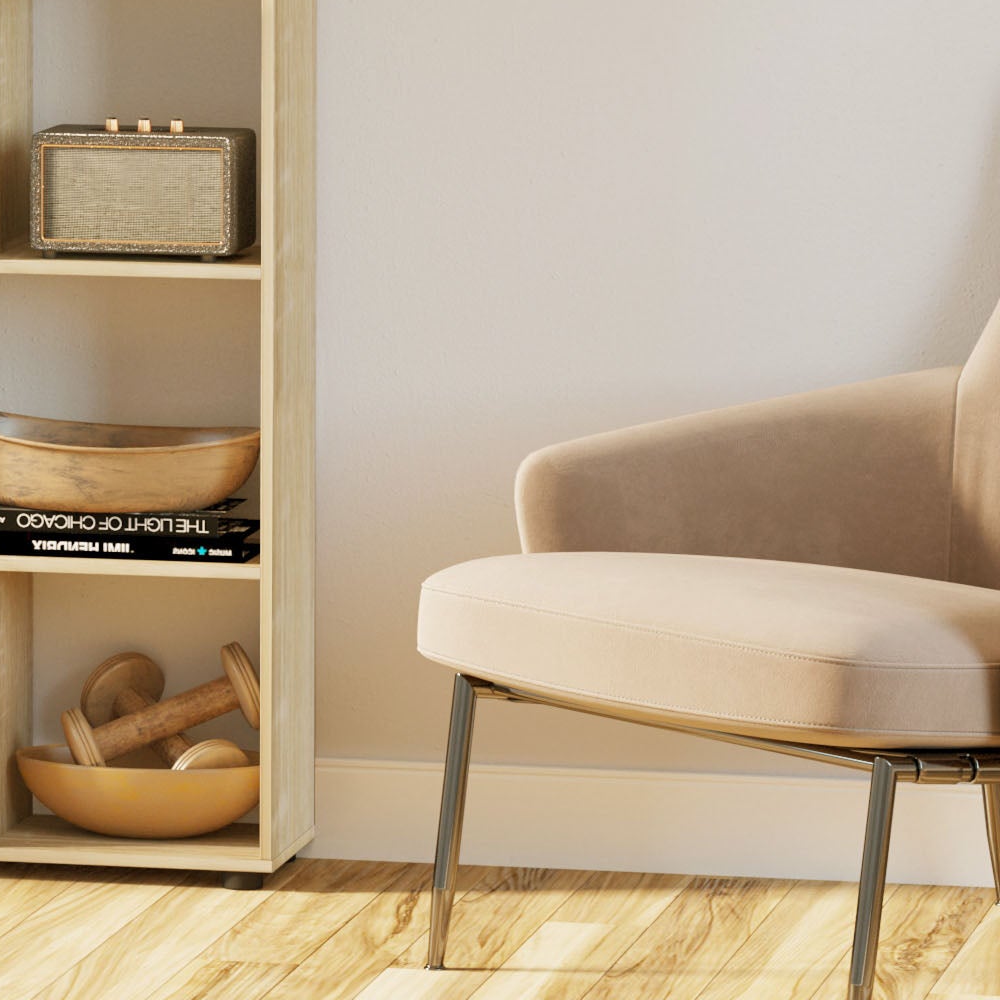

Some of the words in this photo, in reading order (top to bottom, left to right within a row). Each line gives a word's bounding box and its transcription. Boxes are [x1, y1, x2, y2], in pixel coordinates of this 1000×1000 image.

[16, 512, 97, 530] CHICAGO
[98, 515, 122, 531] OF
[124, 516, 174, 533] LIGHT
[175, 518, 209, 533] THE
